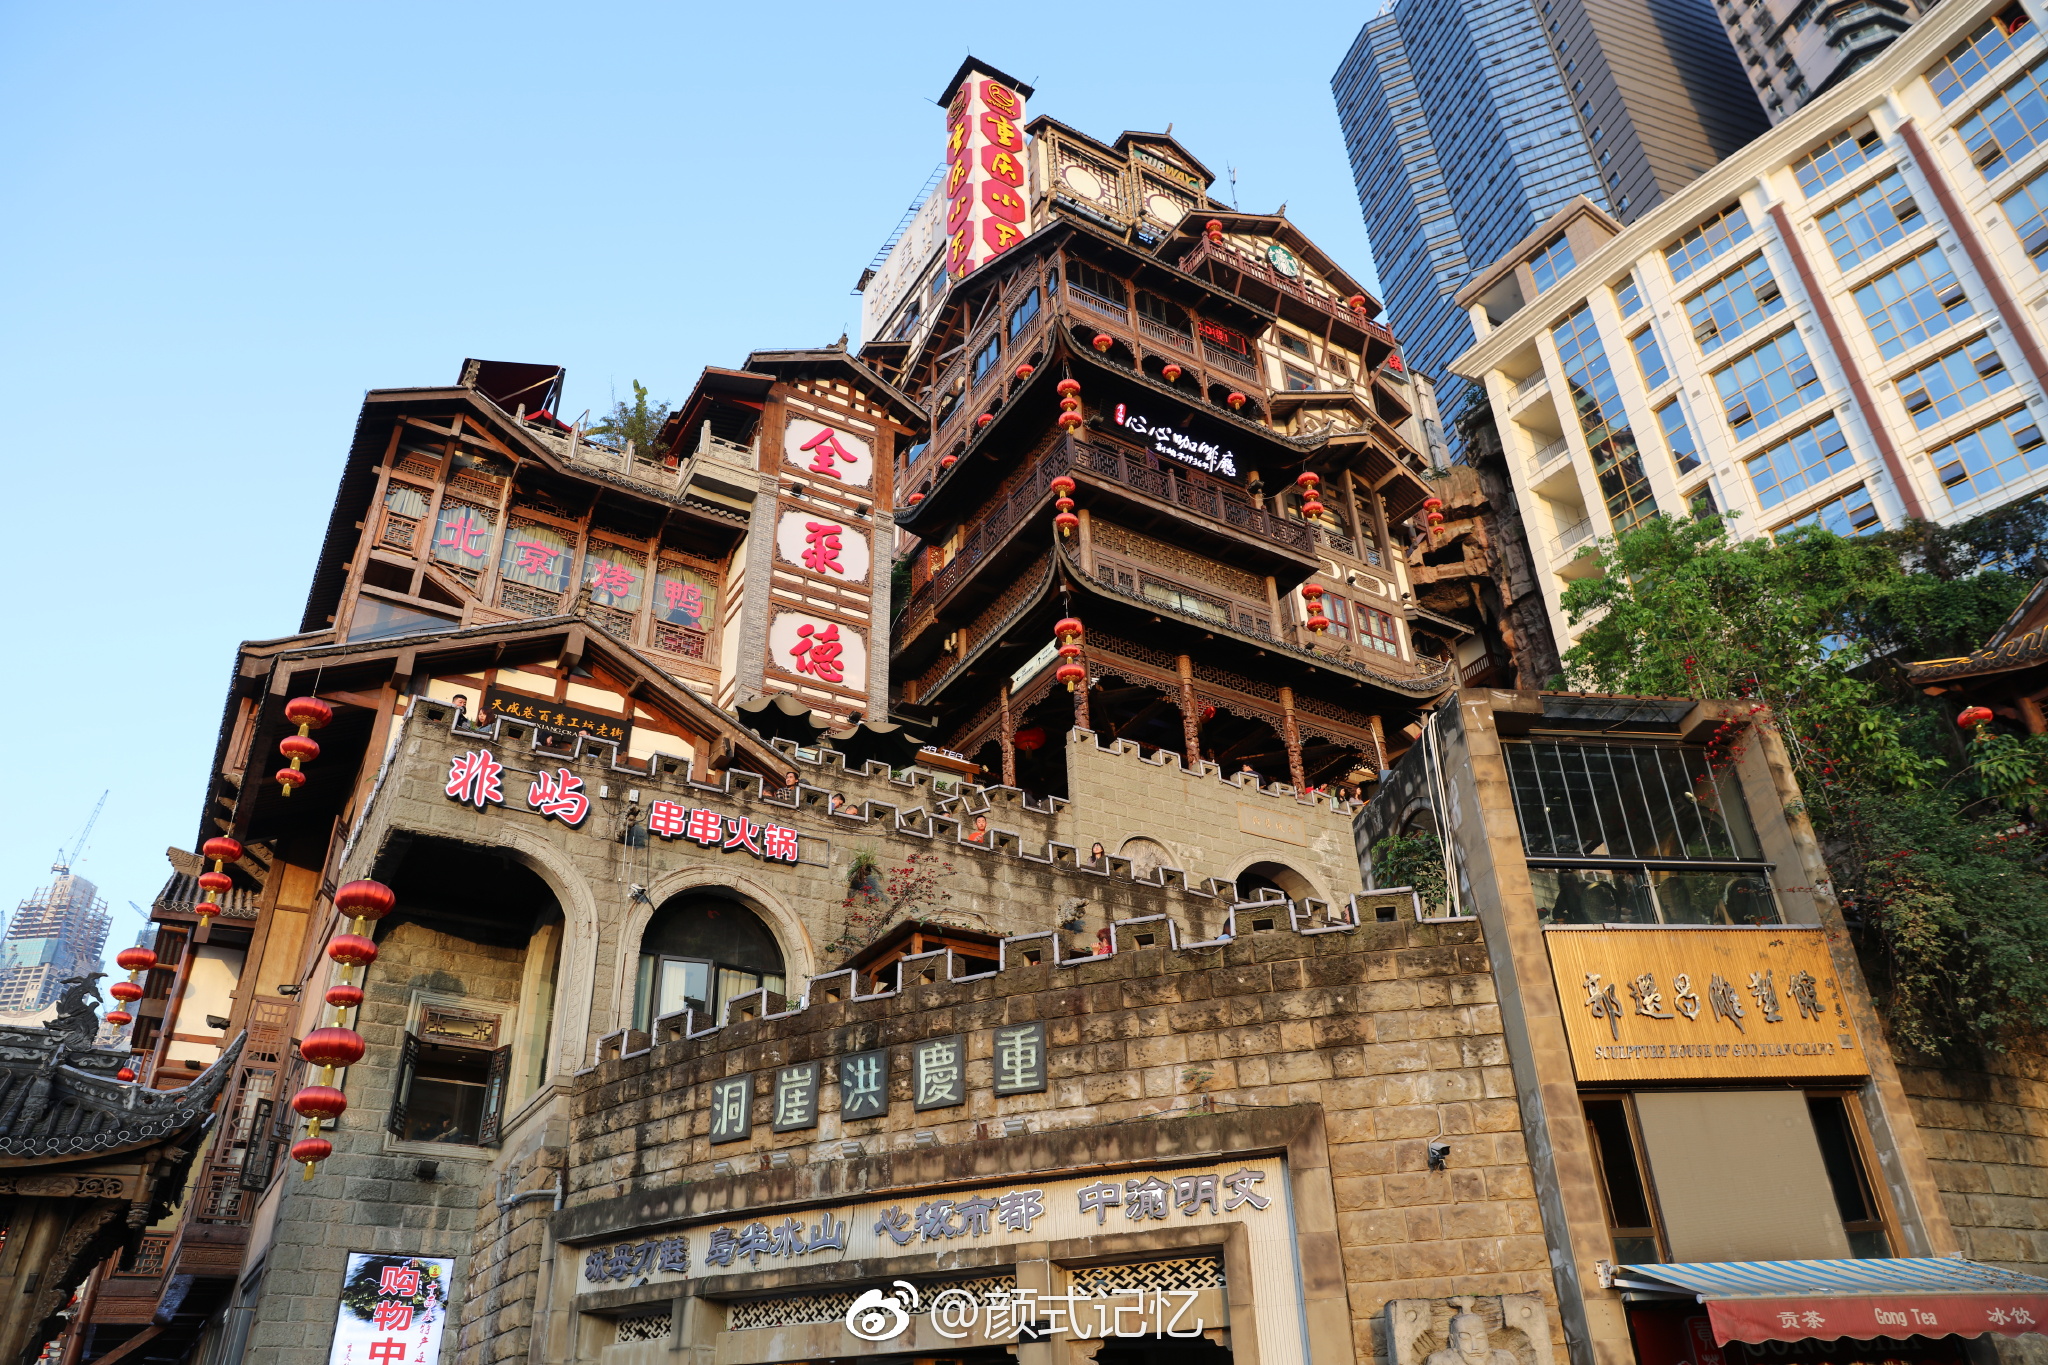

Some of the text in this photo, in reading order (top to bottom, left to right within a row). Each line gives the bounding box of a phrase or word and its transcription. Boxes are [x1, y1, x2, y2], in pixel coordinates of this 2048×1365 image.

[1140, 153, 1198, 185] SUBWAY
[439, 516, 704, 619] 北京烤鸭
[649, 800, 798, 862] 串串火锅
[1595, 1045, 1666, 1060] SCULPTURE
[1669, 1044, 1712, 1058] HOUSE
[1714, 1044, 1730, 1057] OF
[1733, 1043, 1758, 1057] GUO
[1776, 1310, 1827, 1330] 贡茶
[1873, 1306, 1939, 1327] Gong Tea
[1985, 1306, 2037, 1327] 冰饮
